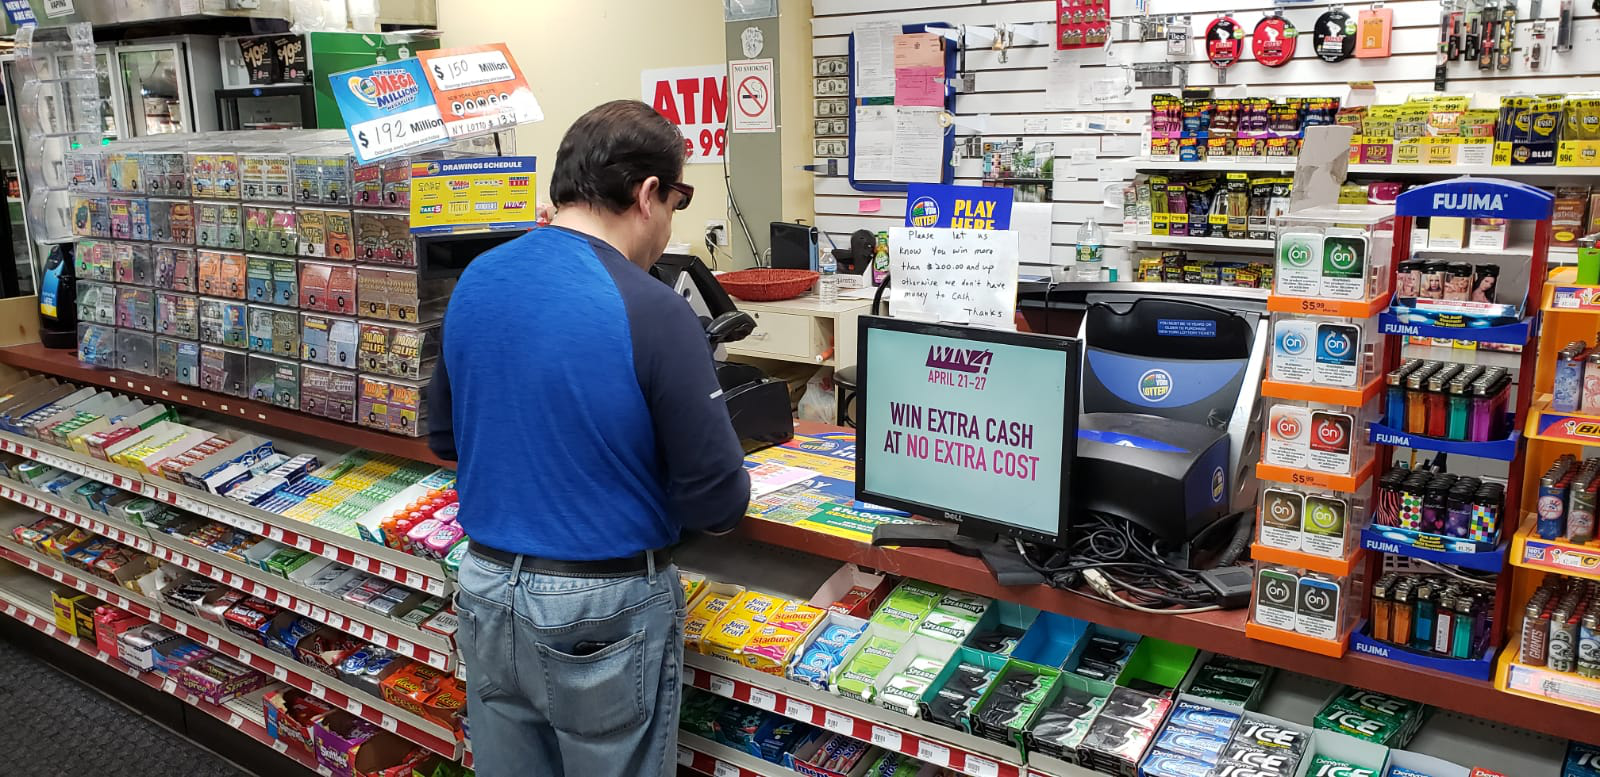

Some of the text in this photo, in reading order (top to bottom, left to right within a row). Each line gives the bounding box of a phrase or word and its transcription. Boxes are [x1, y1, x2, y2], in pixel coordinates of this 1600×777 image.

[434, 59, 508, 80] $ 150 Million
[370, 72, 415, 97] MEGA
[377, 85, 418, 107] MILLIONS
[359, 118, 444, 148] $ 192 Million
[443, 161, 522, 171] DRAWINGS SCHEDULE
[953, 199, 997, 218] PLAY
[1433, 193, 1504, 211] FUJIMA
[951, 217, 996, 230] HERE
[908, 230, 988, 240] Please let us
[952, 246, 968, 255] win
[974, 248, 994, 256] more
[901, 261, 921, 270] than
[966, 262, 980, 270] and
[983, 264, 995, 274] up
[961, 279, 981, 287] don't
[986, 279, 1006, 290] have
[904, 291, 928, 305] money
[936, 291, 945, 300] to
[963, 308, 1003, 318] Thanks
[1385, 323, 1419, 335] FUJIMA
[928, 369, 955, 387] APRIL
[890, 401, 1033, 450] WIN EXTRA CASH
[1376, 433, 1410, 446] FUJIMA
[884, 430, 1040, 481] AT NO EXTRA COST
[944, 511, 964, 522] DELL
[1366, 539, 1400, 554] FUJIMA
[745, 603, 766, 613] Fruit
[752, 598, 771, 607] Juicy
[942, 598, 984, 614] SPEARMINT
[721, 626, 744, 637] Fruit
[729, 620, 749, 630] Juicy
[923, 622, 965, 638] SPEARMINT
[1356, 642, 1388, 657] FUJIMA
[1529, 628, 1542, 659] GIANTS
[1180, 702, 1211, 711] Dentyne
[1328, 709, 1386, 736] ICE
[1244, 726, 1299, 747] ICE
[1233, 750, 1287, 772] ICE
